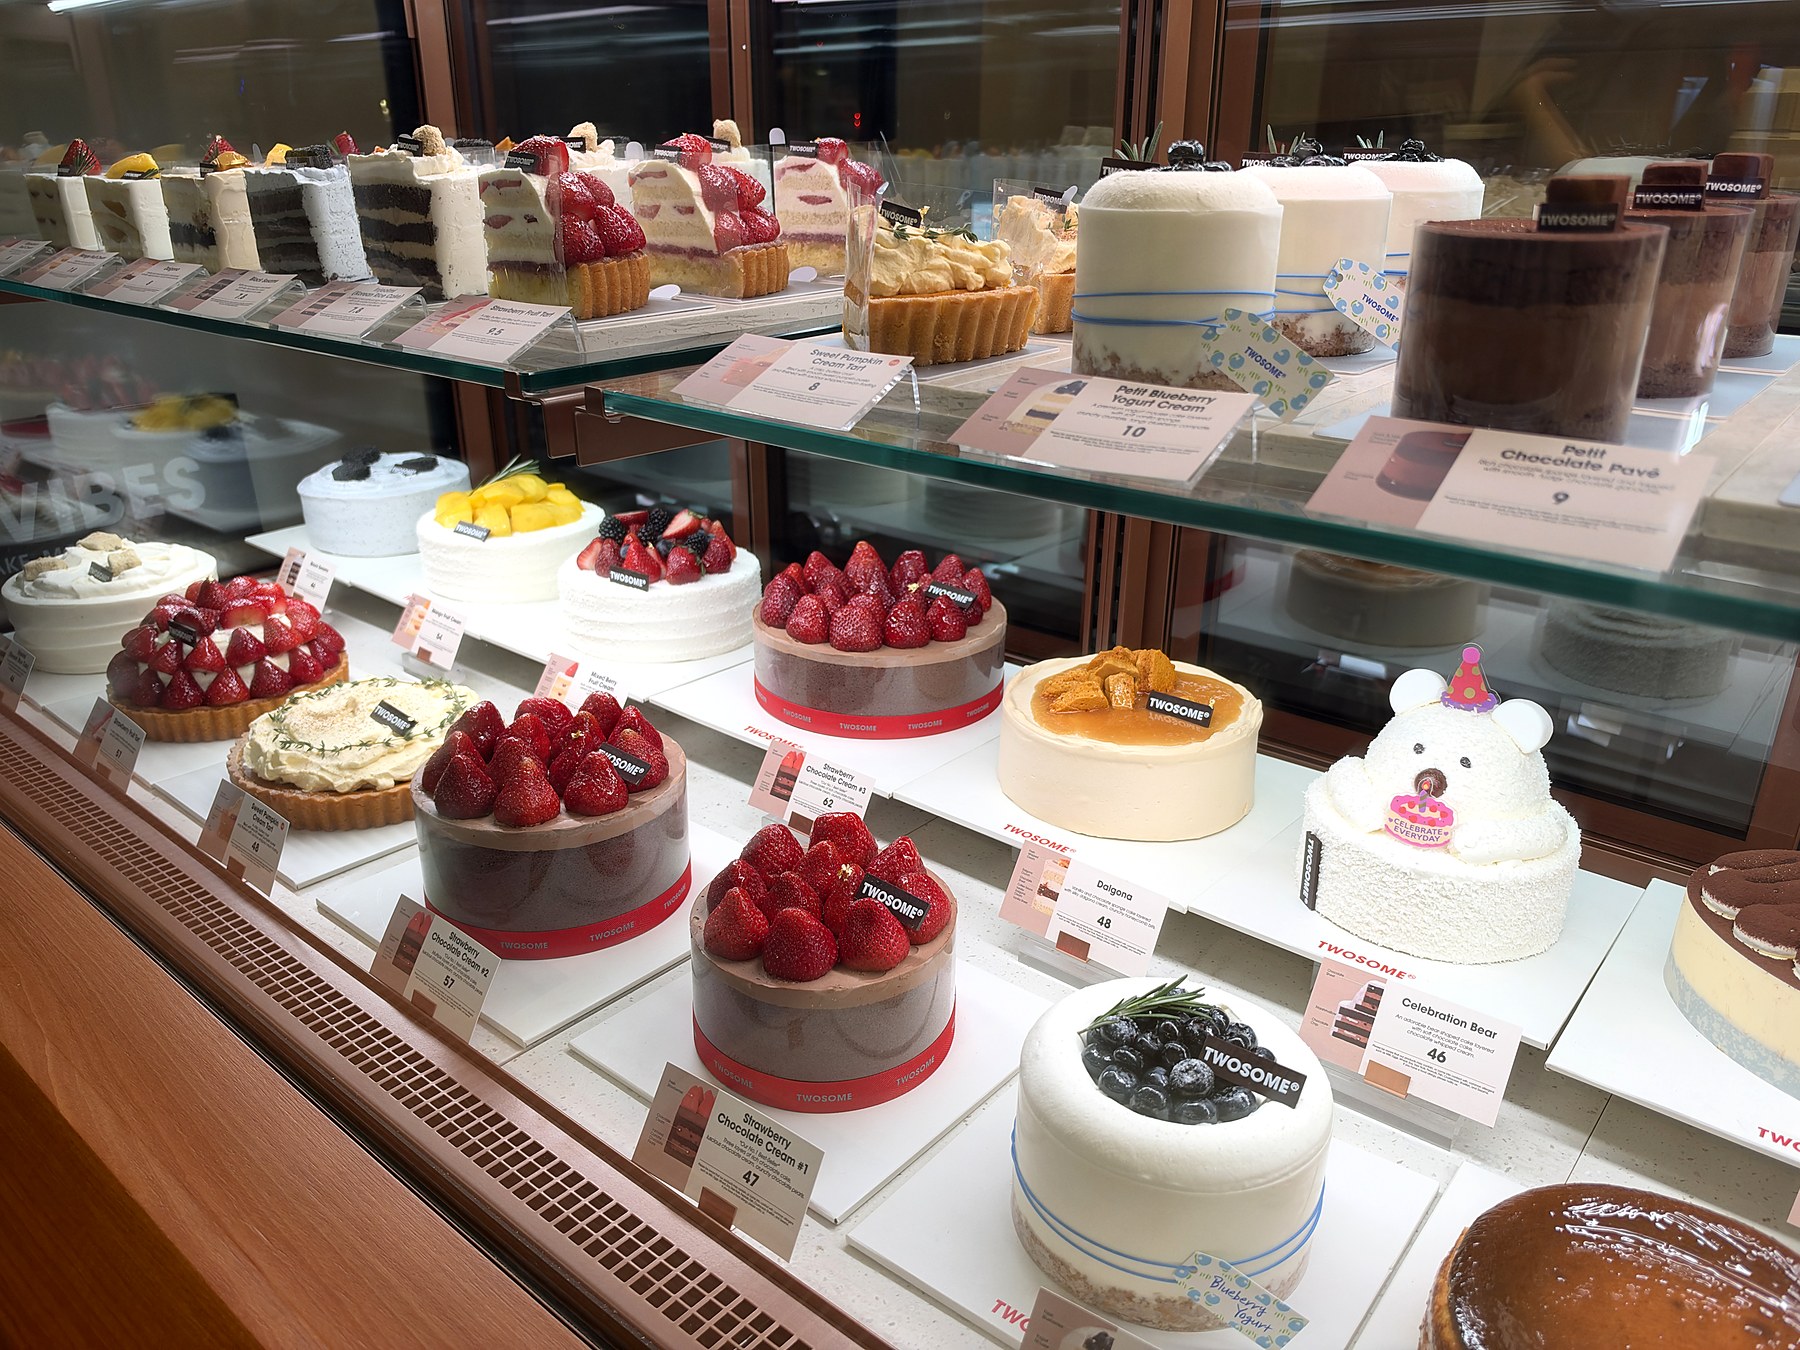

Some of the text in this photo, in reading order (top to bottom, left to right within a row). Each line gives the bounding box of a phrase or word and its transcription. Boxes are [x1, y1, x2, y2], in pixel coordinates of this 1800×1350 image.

[487, 305, 528, 315] Strawberry
[484, 327, 506, 335] 9.5
[808, 348, 885, 366] Sweet Pumpkin
[810, 357, 847, 368] Cream
[844, 363, 867, 371] Tart
[806, 381, 822, 391] 8
[1113, 385, 1217, 405] Petit Blueberry
[1107, 394, 1157, 408] Yogurt
[1154, 400, 1207, 413] Cream
[1119, 425, 1148, 437] 10
[1560, 444, 1609, 459] Petit
[1498, 449, 1662, 479] Chocolate Pavé
[1548, 490, 1571, 506] 9
[590, 671, 617, 686] Mixed Berry
[597, 681, 615, 691] Cream
[783, 708, 812, 723] TWOSOME
[908, 719, 943, 730] TWOSOME
[839, 722, 877, 732] TWOSOME
[805, 764, 837, 782] Chocolate
[836, 777, 858, 791] Cream
[858, 785, 866, 794] #3
[821, 762, 855, 781] Strawberry
[822, 796, 834, 808] 62
[1393, 818, 1443, 836] CELEBRATE
[1393, 825, 1442, 843] EVERYDAY
[250, 839, 260, 852] 48
[663, 885, 687, 909] TWOSOME
[1095, 879, 1133, 903] Dalgona
[590, 921, 635, 941] TWOSOME
[1096, 914, 1112, 929] 48
[430, 930, 462, 958] Chocolate
[460, 951, 481, 972] Cream
[480, 966, 489, 978] #2
[447, 930, 480, 960] Strawberry
[500, 941, 548, 950] TWOSOME
[442, 974, 455, 990] 57
[1400, 996, 1498, 1040] Celebration Bear
[1402, 1016, 1426, 1028] adorable
[1459, 1037, 1474, 1046] cake
[1473, 1042, 1494, 1055] layered
[1405, 1028, 1433, 1042] chocolate
[1433, 1039, 1456, 1052] whipped
[1410, 1024, 1422, 1033] with
[1431, 1032, 1458, 1046] chocolate
[1426, 1045, 1447, 1064] 46
[713, 1060, 754, 1089] TWOSOME
[896, 1055, 935, 1087] TWOSOME
[796, 1092, 853, 1103] TWOSOME
[741, 1111, 792, 1151] Strawberry
[716, 1111, 808, 1175] Chocolate Cream #1
[722, 1136, 734, 1148] Three
[733, 1143, 746, 1156] layers
[745, 1150, 752, 1159] of
[750, 1154, 759, 1163] rich
[757, 1158, 780, 1176] chocolate
[720, 1142, 741, 1159] chocolate
[754, 1163, 771, 1178] crunchy
[770, 1173, 791, 1191] chocolate
[741, 1167, 759, 1188] 47
[1209, 1276, 1267, 1316] Blueberry
[1234, 1307, 1274, 1333] Yogurt
